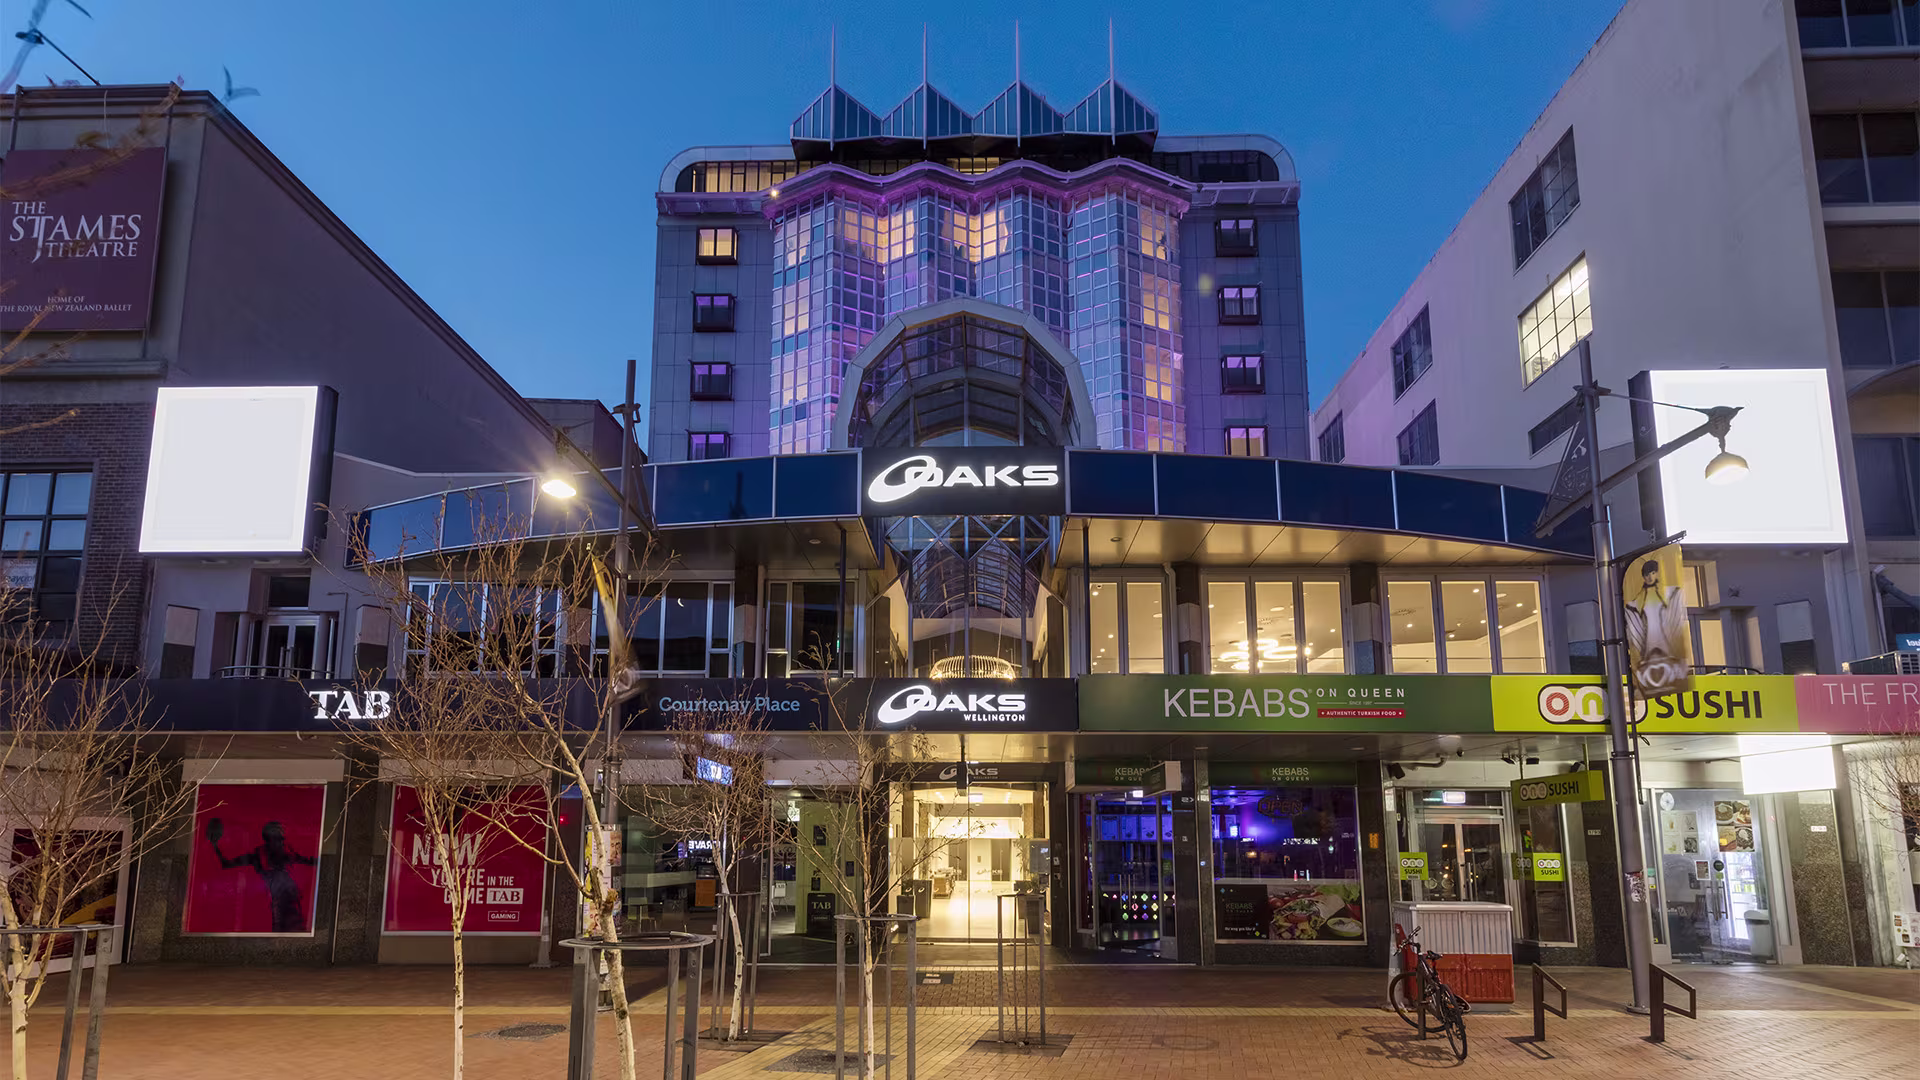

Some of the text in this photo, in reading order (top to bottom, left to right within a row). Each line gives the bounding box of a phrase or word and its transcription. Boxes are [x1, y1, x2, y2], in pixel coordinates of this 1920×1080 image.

[12, 201, 46, 214] THE
[45, 241, 138, 258] THEATRE
[65, 304, 102, 312] ZEALAND
[104, 303, 132, 311] BALLET
[868, 455, 1059, 503] OAKS
[1316, 688, 1405, 698] ON QUEEN
[1822, 682, 1877, 705] THE
[308, 690, 391, 720] TAB
[659, 697, 801, 715] Courtenay Place
[877, 684, 1026, 724] OAKS
[1163, 688, 1311, 719] KEBABS
[1656, 690, 1763, 720] SUSHI
[964, 713, 1026, 722] WELLINGTON
[1271, 767, 1309, 776] KEBABS
[1549, 781, 1579, 796] SUSHI
[1259, 800, 1304, 814] OPEN
[412, 833, 484, 866] NOW
[1537, 859, 1561, 868] one
[487, 876, 515, 886] IN THE
[443, 887, 520, 904] GME TAB
[811, 901, 831, 910] TAB
